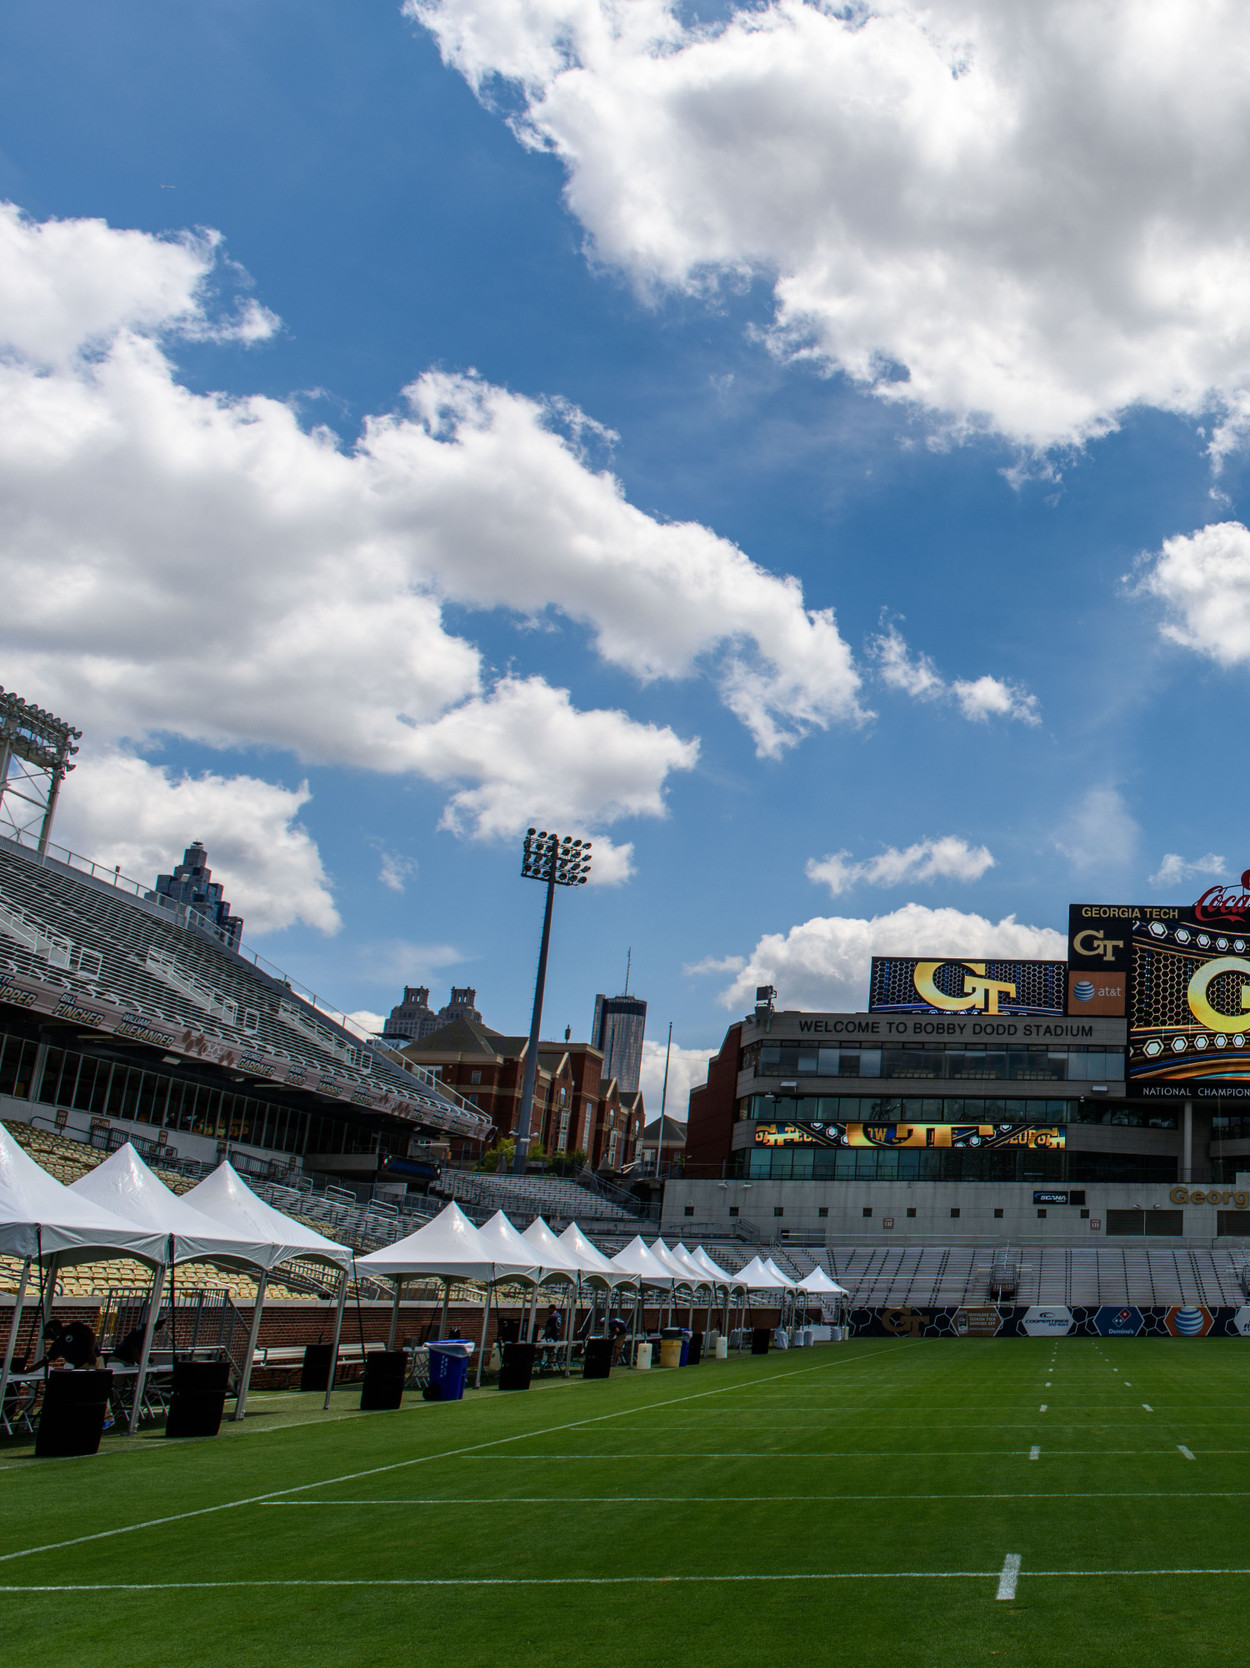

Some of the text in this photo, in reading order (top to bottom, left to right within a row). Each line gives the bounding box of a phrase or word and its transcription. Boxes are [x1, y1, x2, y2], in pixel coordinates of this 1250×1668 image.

[1081, 907, 1178, 919] GEORGIA TECH
[1073, 930, 1124, 961] GT
[913, 961, 1017, 1016] GT
[1098, 987, 1121, 997] at&t
[60, 993, 77, 1005] BILL
[53, 1003, 104, 1027] FINCHER
[122, 1012, 152, 1027] WILLIAM
[114, 1022, 175, 1048] ALEXANDER
[799, 1020, 1093, 1037] WELCOME TO BOBBY DODD STADIUM
[237, 1057, 276, 1077] GARDNER
[1142, 1087, 1192, 1096] NATIONAL
[881, 1308, 930, 1337] GT
